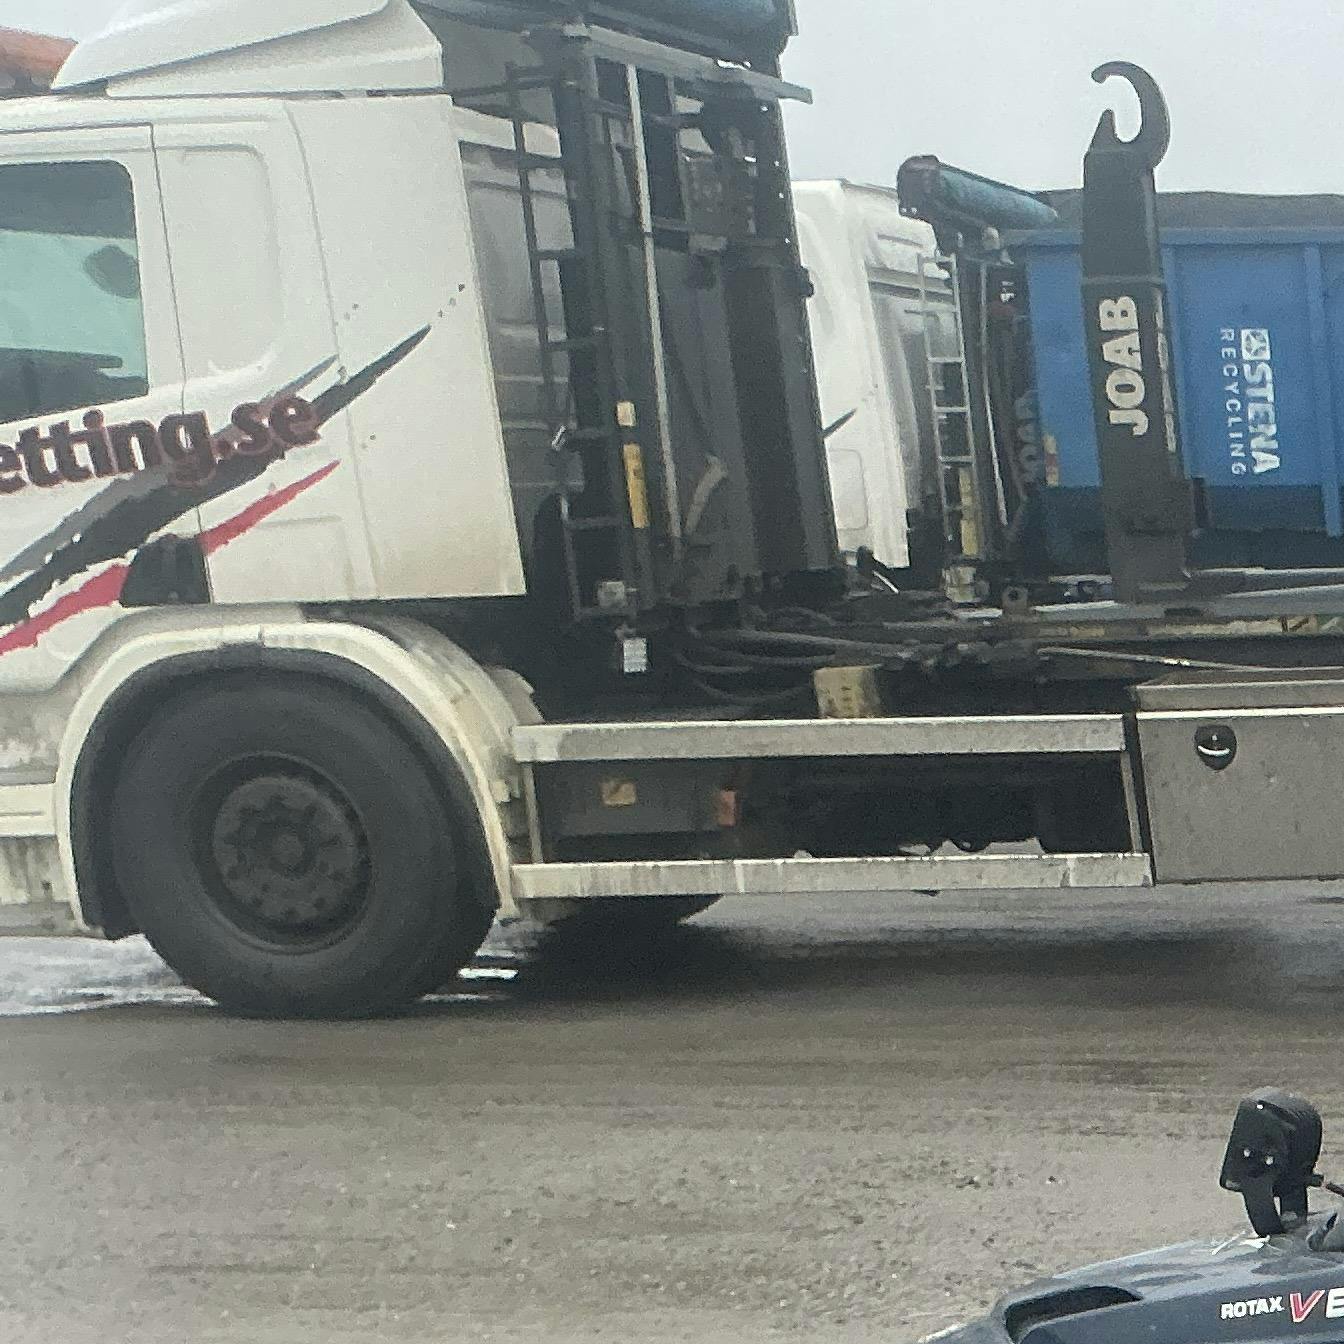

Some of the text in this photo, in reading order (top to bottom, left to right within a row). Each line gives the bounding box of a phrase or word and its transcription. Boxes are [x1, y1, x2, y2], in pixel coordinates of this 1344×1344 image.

[1099, 296, 1148, 436] JOAB
[1220, 328, 1247, 476] RECYCLING
[1243, 361, 1281, 474] STENA
[1220, 1296, 1285, 1320] ROTAX
